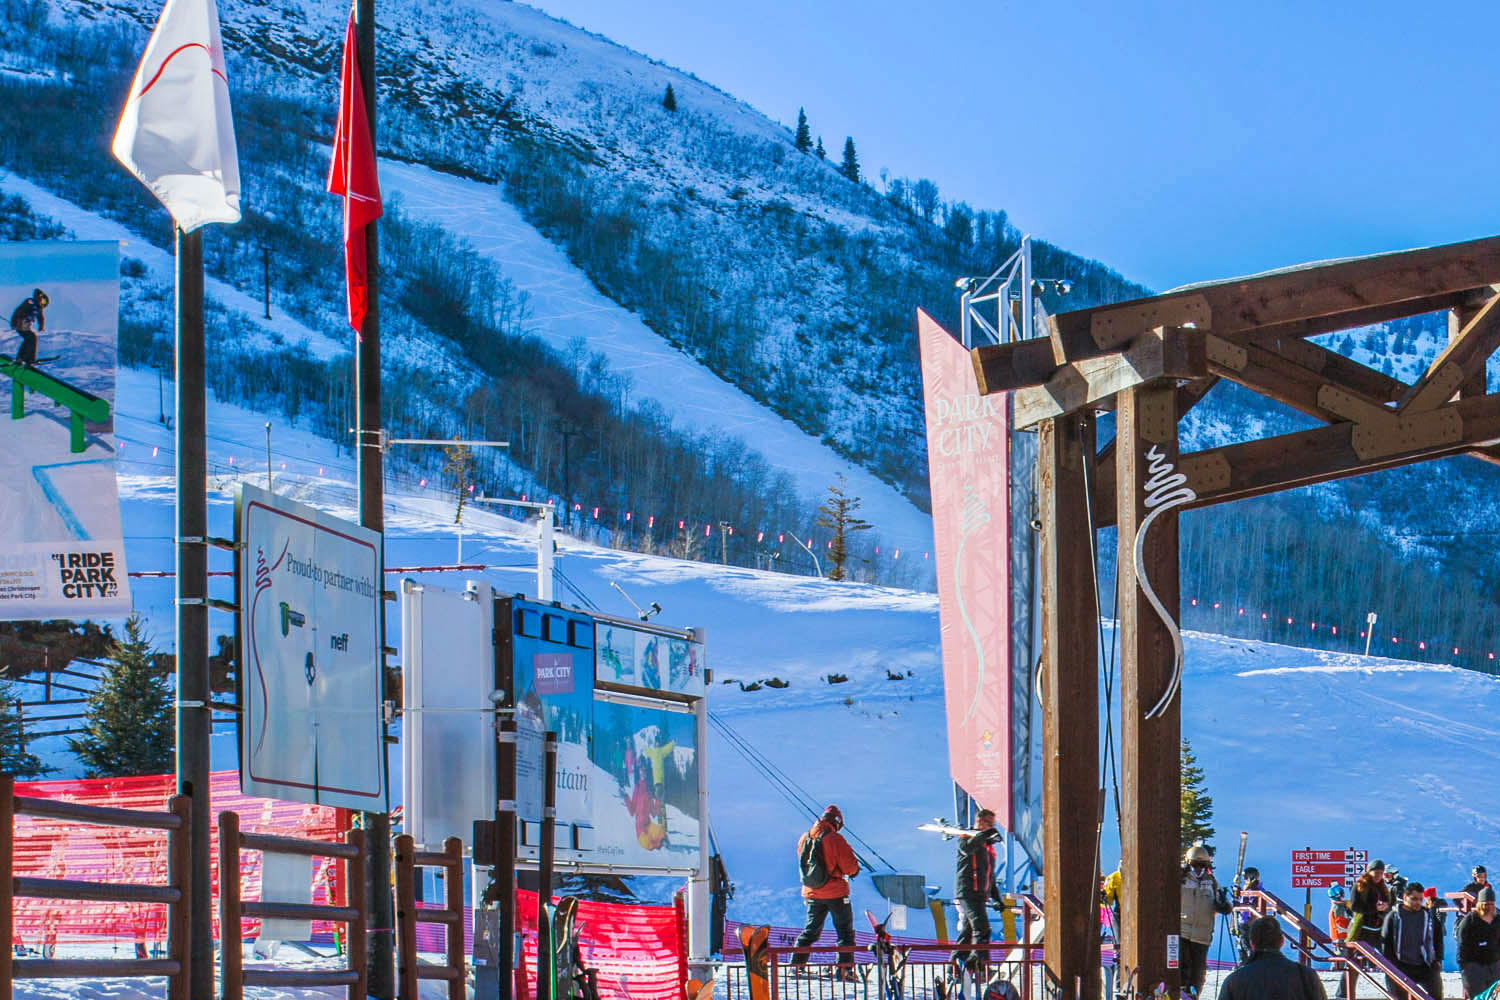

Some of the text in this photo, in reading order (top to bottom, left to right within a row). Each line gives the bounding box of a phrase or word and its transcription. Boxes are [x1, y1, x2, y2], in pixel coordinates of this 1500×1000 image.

[936, 393, 998, 427] PARK
[940, 421, 993, 456] CITY
[69, 552, 114, 568] RIDE
[61, 567, 116, 583] PARK
[287, 552, 312, 579] Proud
[313, 564, 322, 582] to
[323, 569, 354, 590] partner
[330, 633, 349, 652] neff
[536, 666, 571, 679] PARK CITY
[1295, 852, 1331, 860] FIRST TIME
[1295, 865, 1315, 873] EAGLE
[1302, 878, 1322, 886] KINGS
